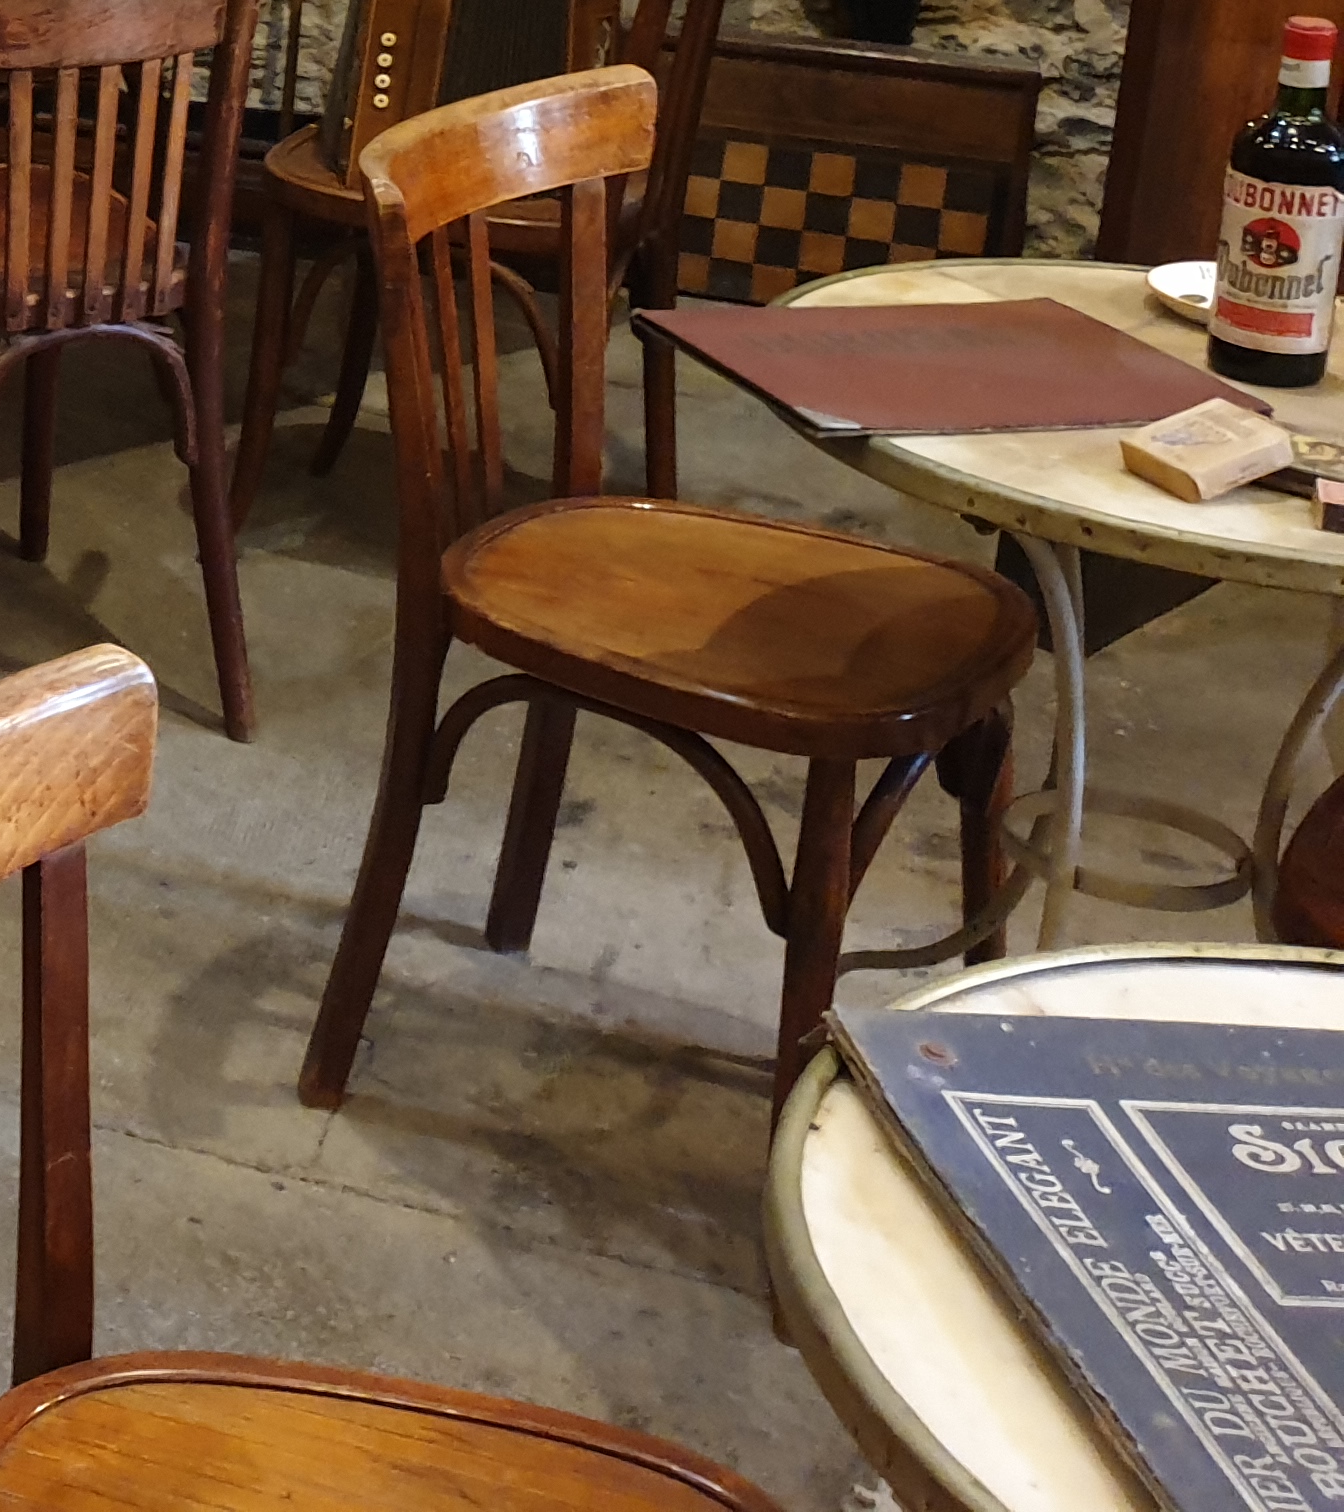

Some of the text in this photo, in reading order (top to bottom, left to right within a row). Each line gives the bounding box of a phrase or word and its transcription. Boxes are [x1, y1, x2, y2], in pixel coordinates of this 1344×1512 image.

[973, 1108, 1108, 1248] ELEGANT
[1083, 1258, 1208, 1378] MONDE
[1180, 1386, 1255, 1440] DU
